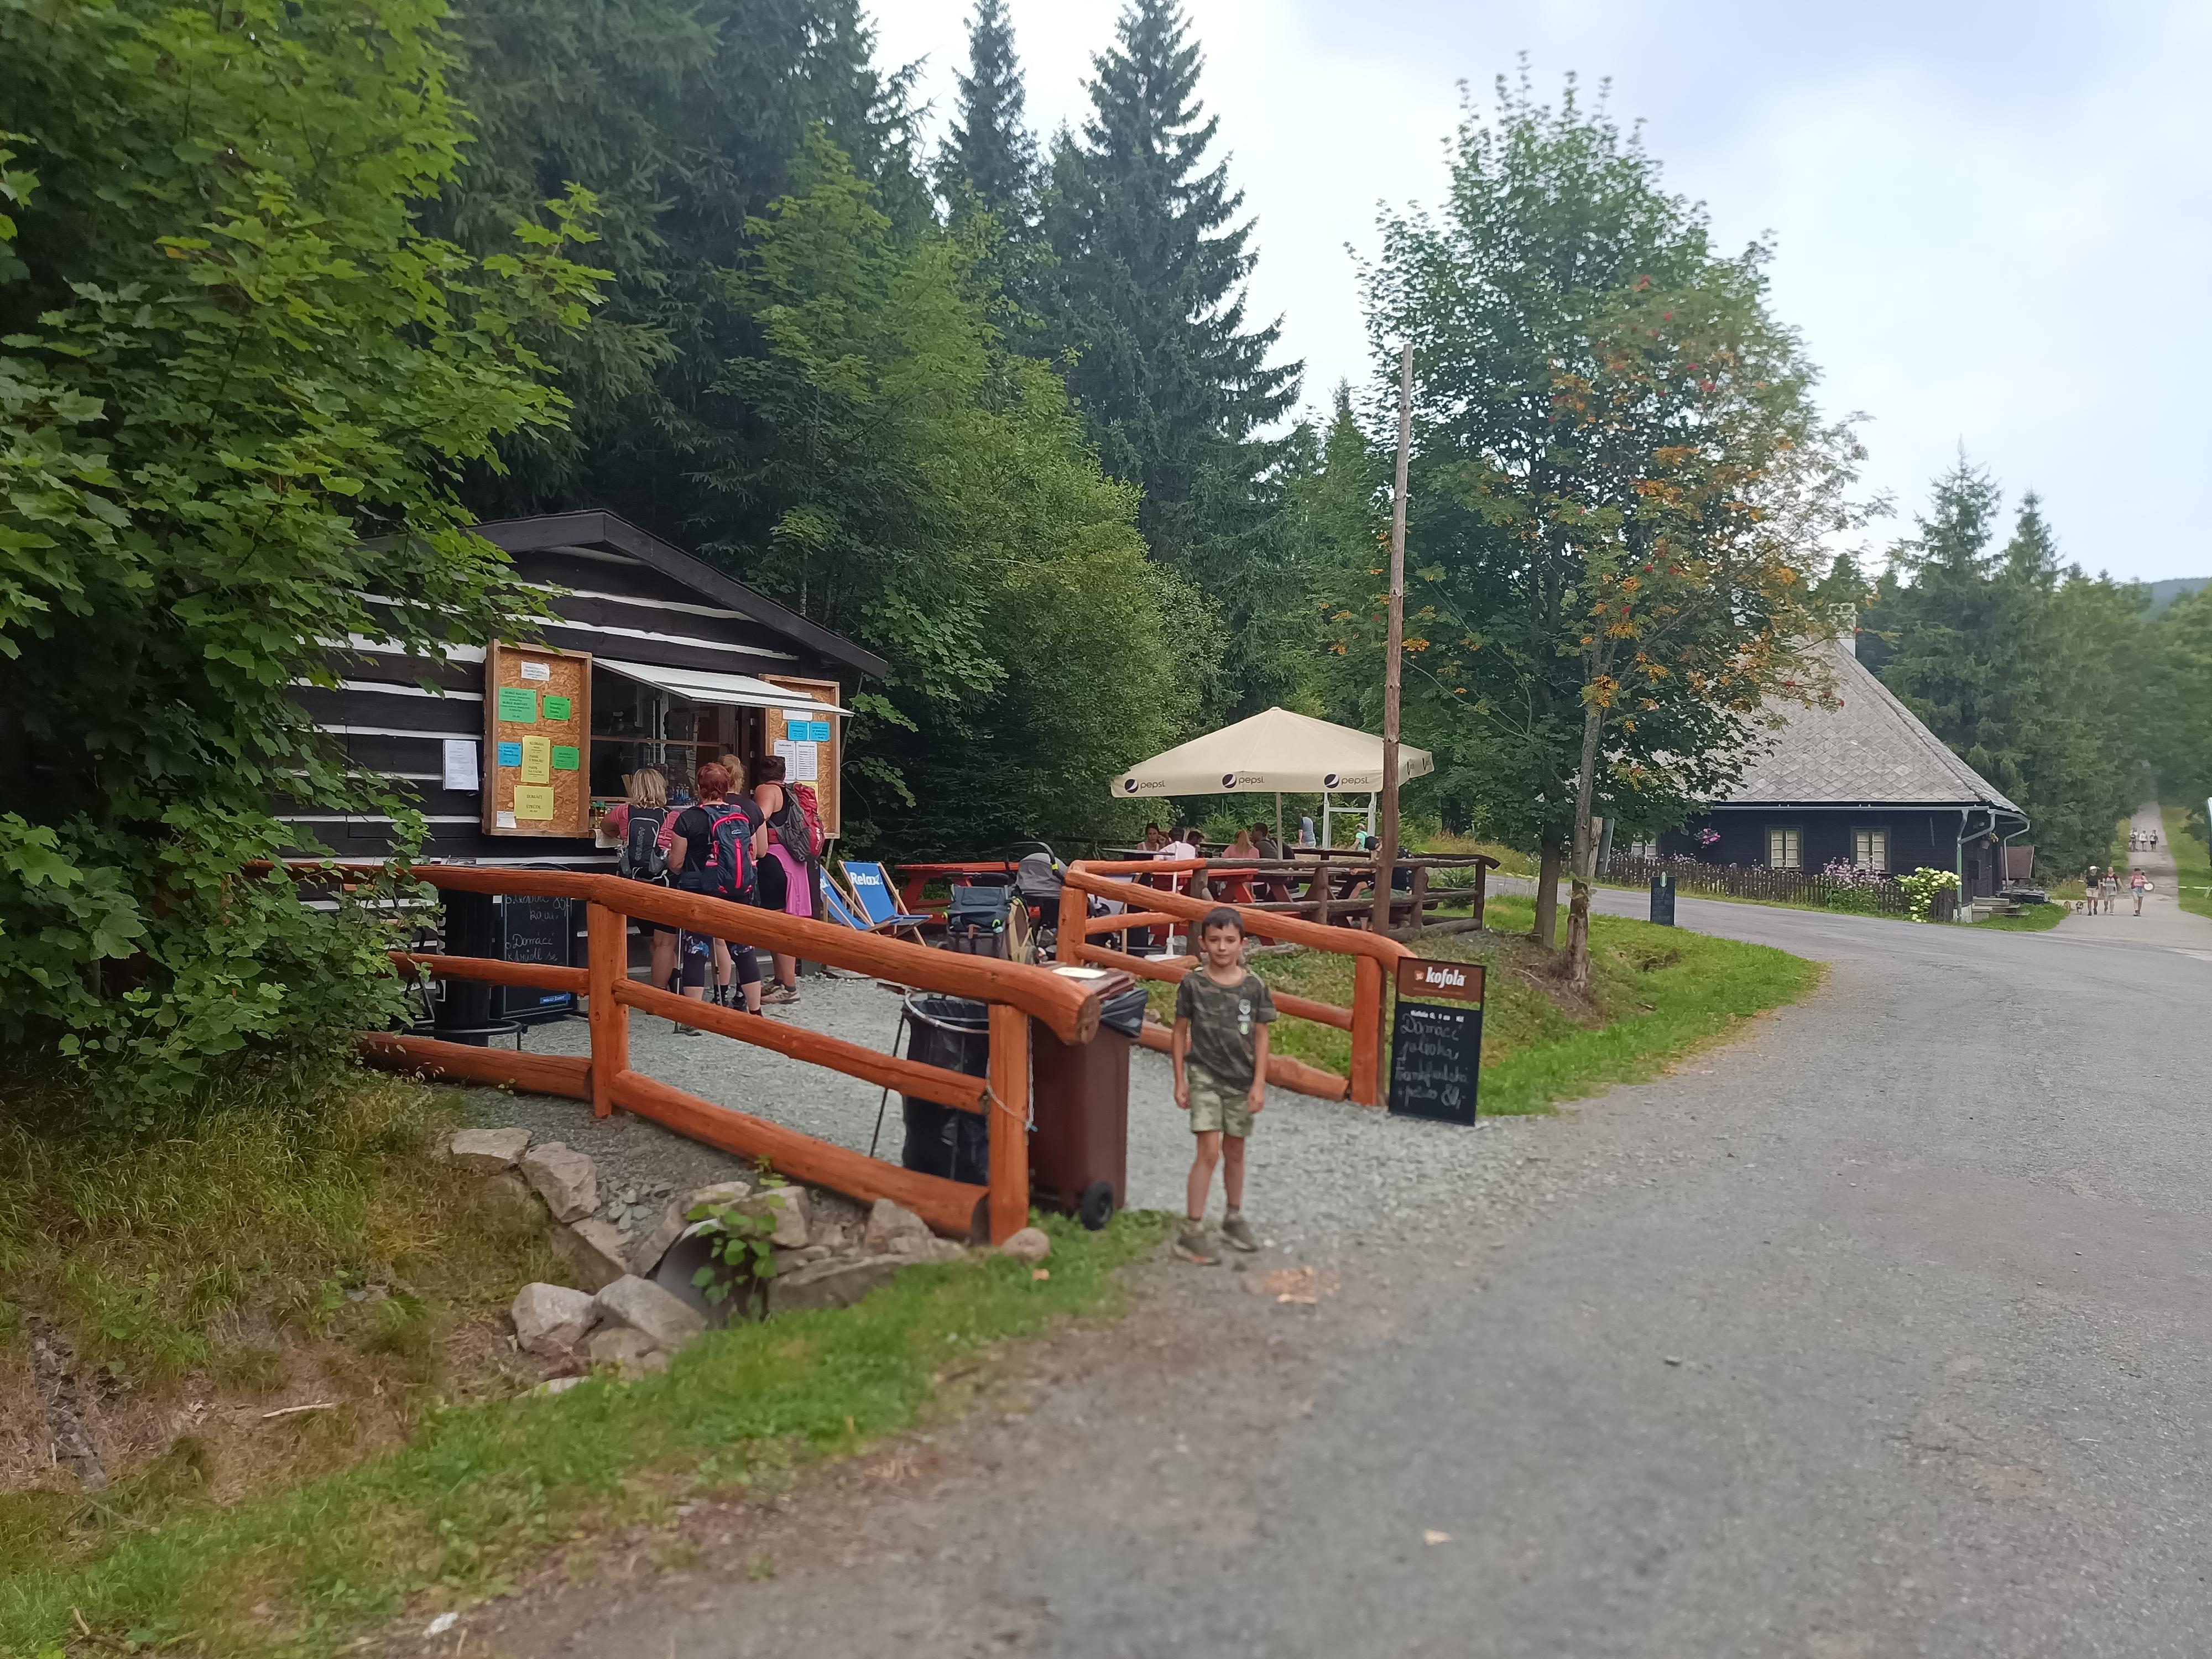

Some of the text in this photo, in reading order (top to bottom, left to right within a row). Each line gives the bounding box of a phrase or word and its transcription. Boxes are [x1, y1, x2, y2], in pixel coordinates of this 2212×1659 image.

[1140, 780, 1166, 789] pepsi
[1239, 776, 1265, 785] pepsi
[1341, 776, 1369, 785] pepsi
[1425, 966, 1467, 989] kofola
